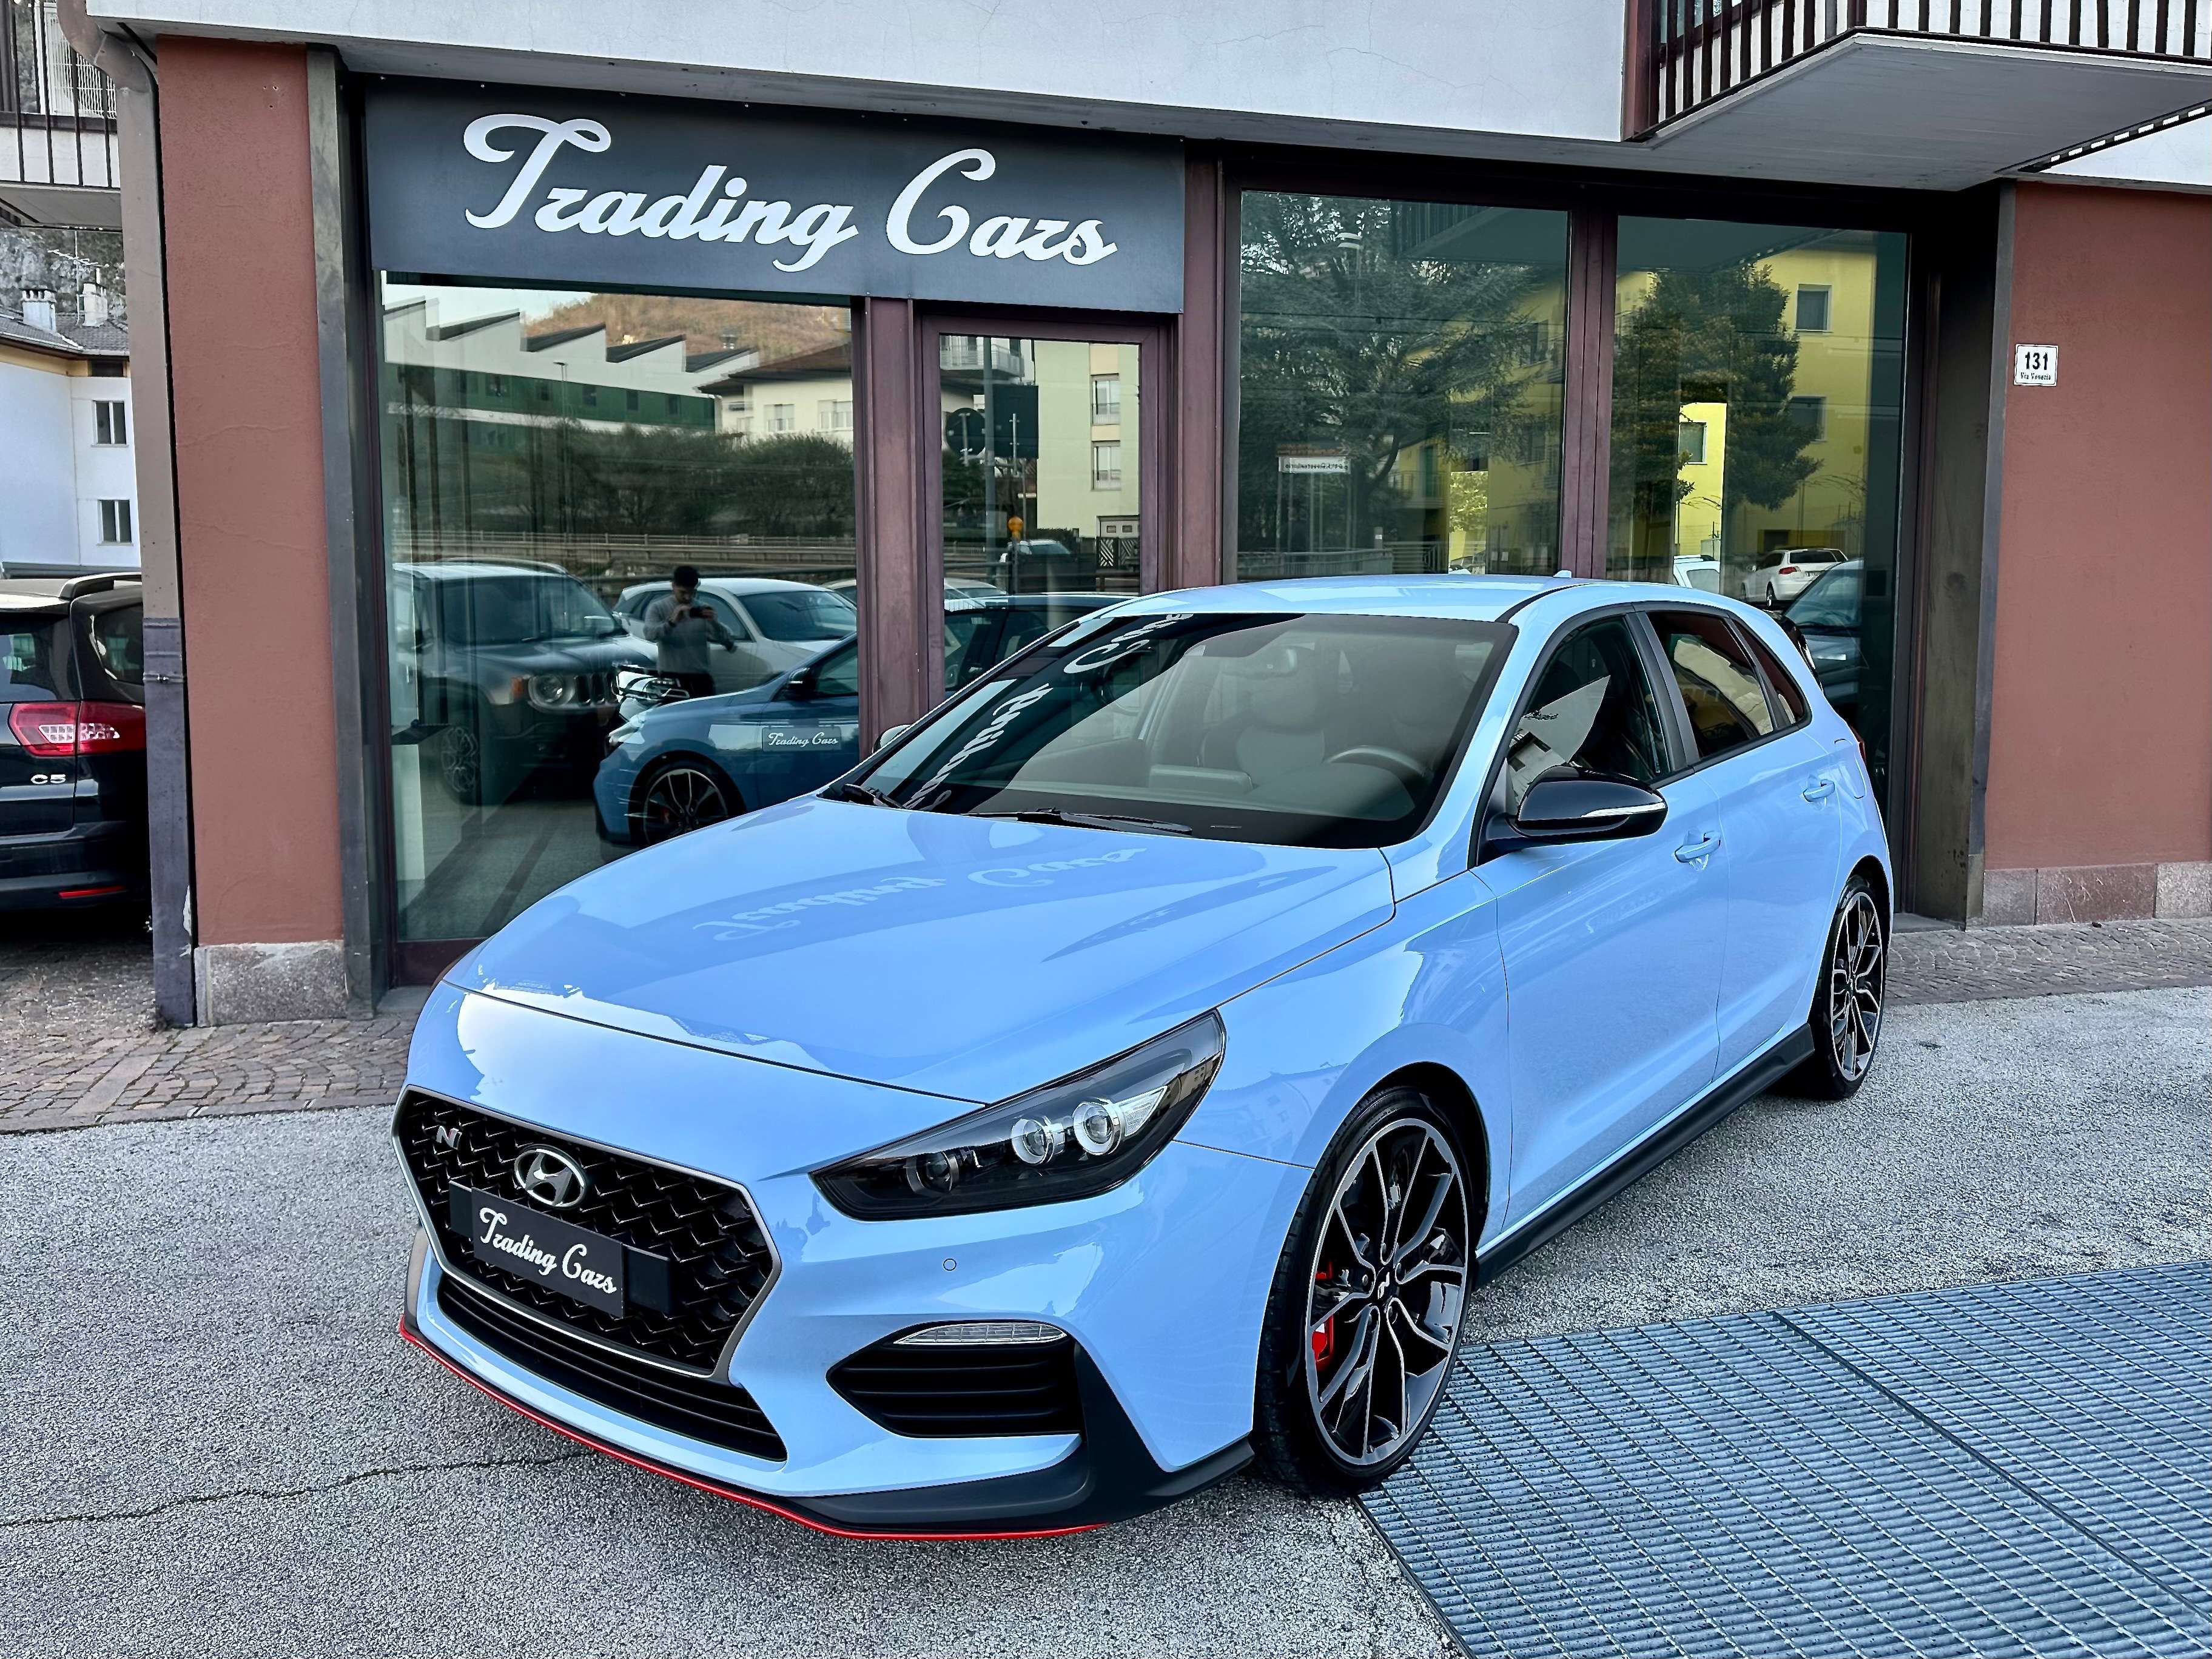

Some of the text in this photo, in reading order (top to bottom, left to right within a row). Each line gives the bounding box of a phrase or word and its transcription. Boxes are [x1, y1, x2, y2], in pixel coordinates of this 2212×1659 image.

[463, 113, 1118, 273] Trading Cars
[2025, 352, 2049, 371] 131
[2031, 372, 2051, 381] Venezia
[768, 732, 839, 748] Trading Cars
[30, 773, 66, 785] C5
[435, 1125, 462, 1150] N
[479, 1207, 617, 1294] Trading Cars
